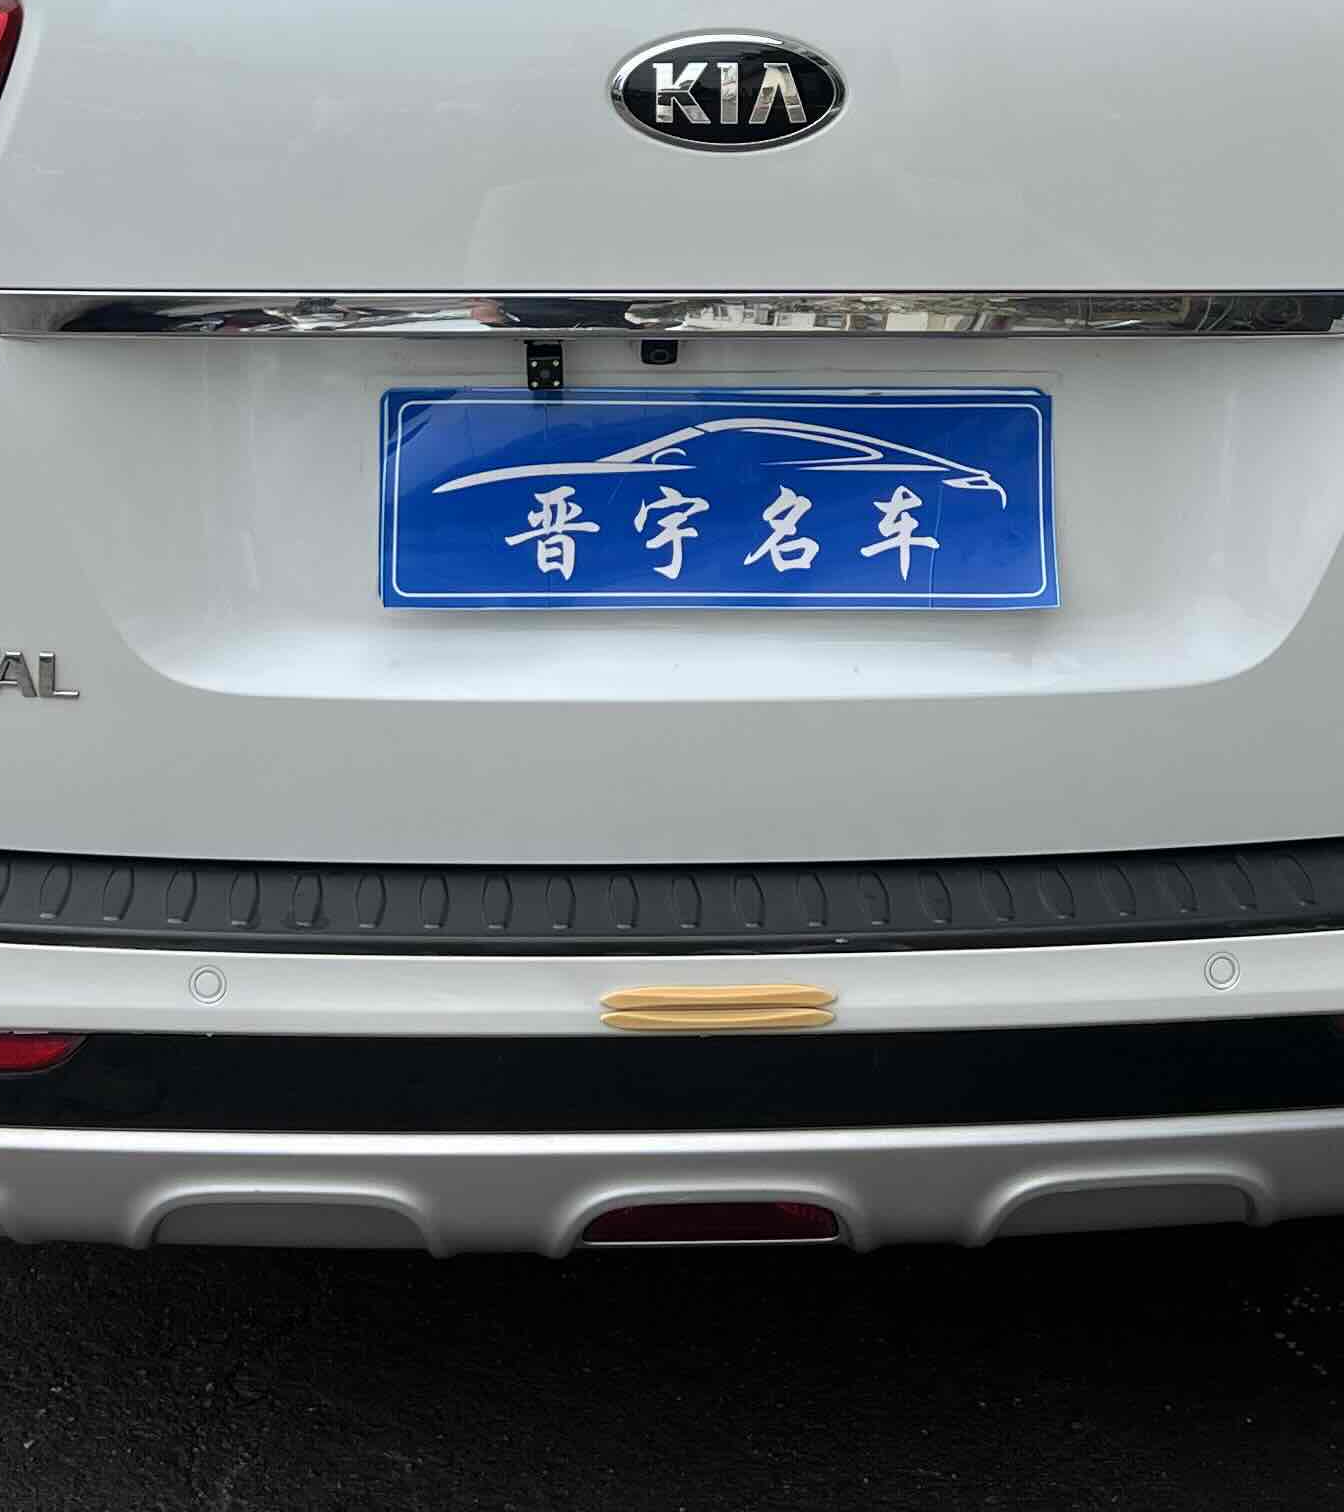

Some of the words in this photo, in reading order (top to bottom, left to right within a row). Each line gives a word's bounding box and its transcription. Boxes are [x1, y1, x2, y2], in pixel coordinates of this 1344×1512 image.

[652, 62, 808, 125] KIA
[505, 484, 940, 582] 晋宇名车
